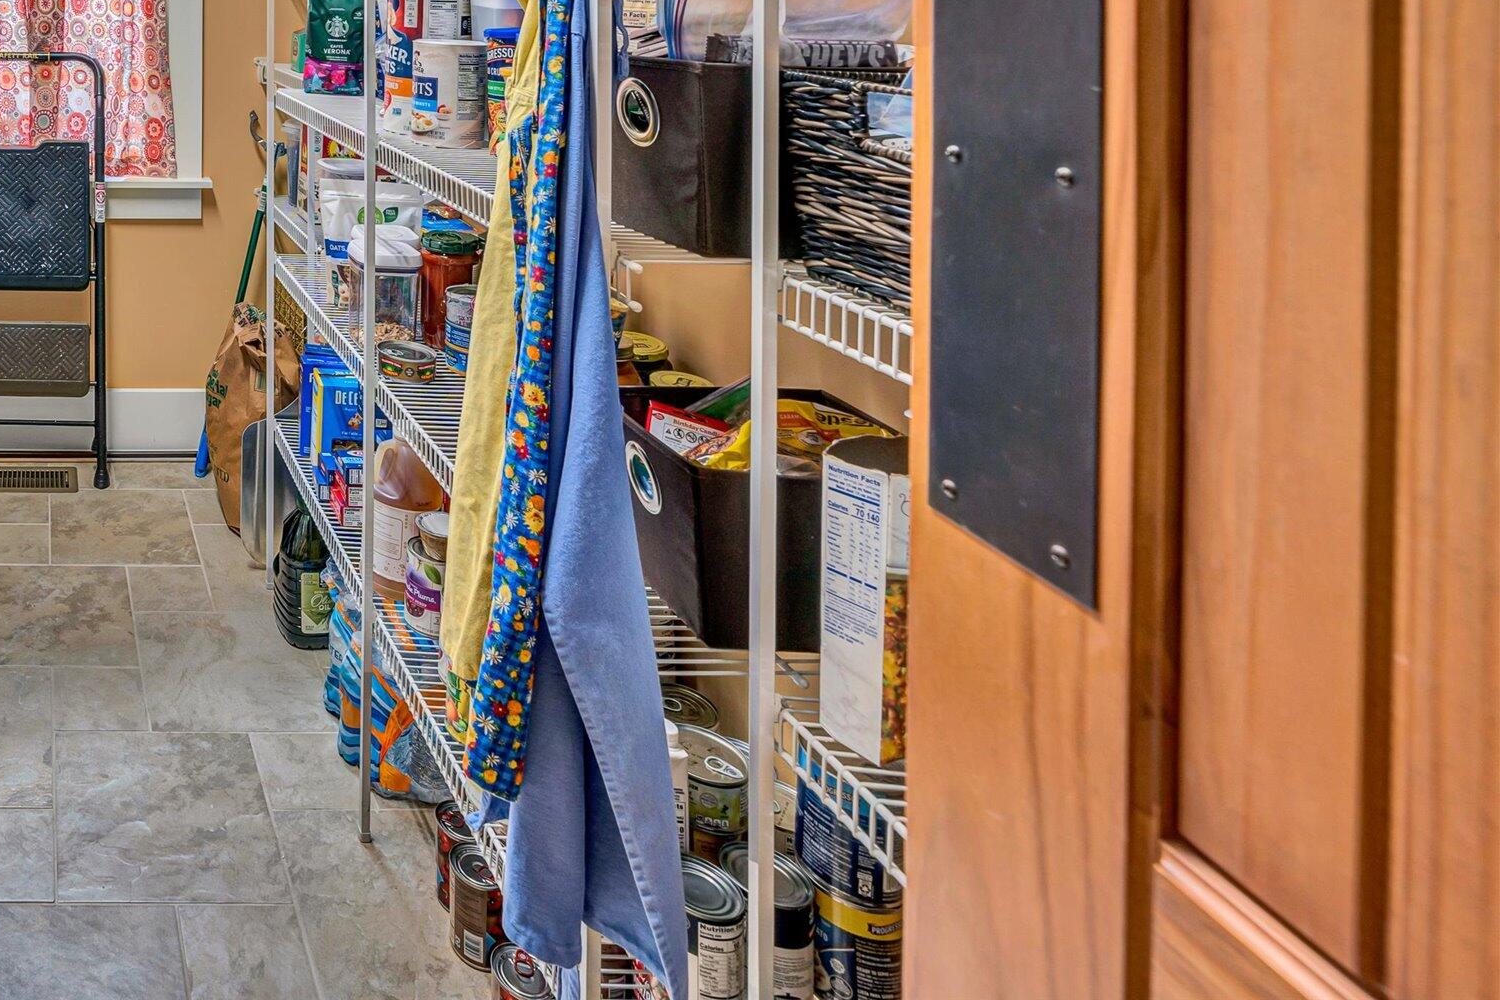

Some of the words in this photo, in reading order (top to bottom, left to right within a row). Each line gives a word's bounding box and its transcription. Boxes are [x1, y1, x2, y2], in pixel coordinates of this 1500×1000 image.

[629, 11, 646, 19] Facts
[672, 418, 699, 431] Birthday
[828, 464, 859, 480] Nutrition
[860, 475, 881, 487] Facts
[828, 499, 849, 513] Calories
[855, 507, 865, 518] 70
[866, 510, 880, 523] 140
[700, 924, 736, 933] Nutrition
[700, 943, 724, 951] Calories
